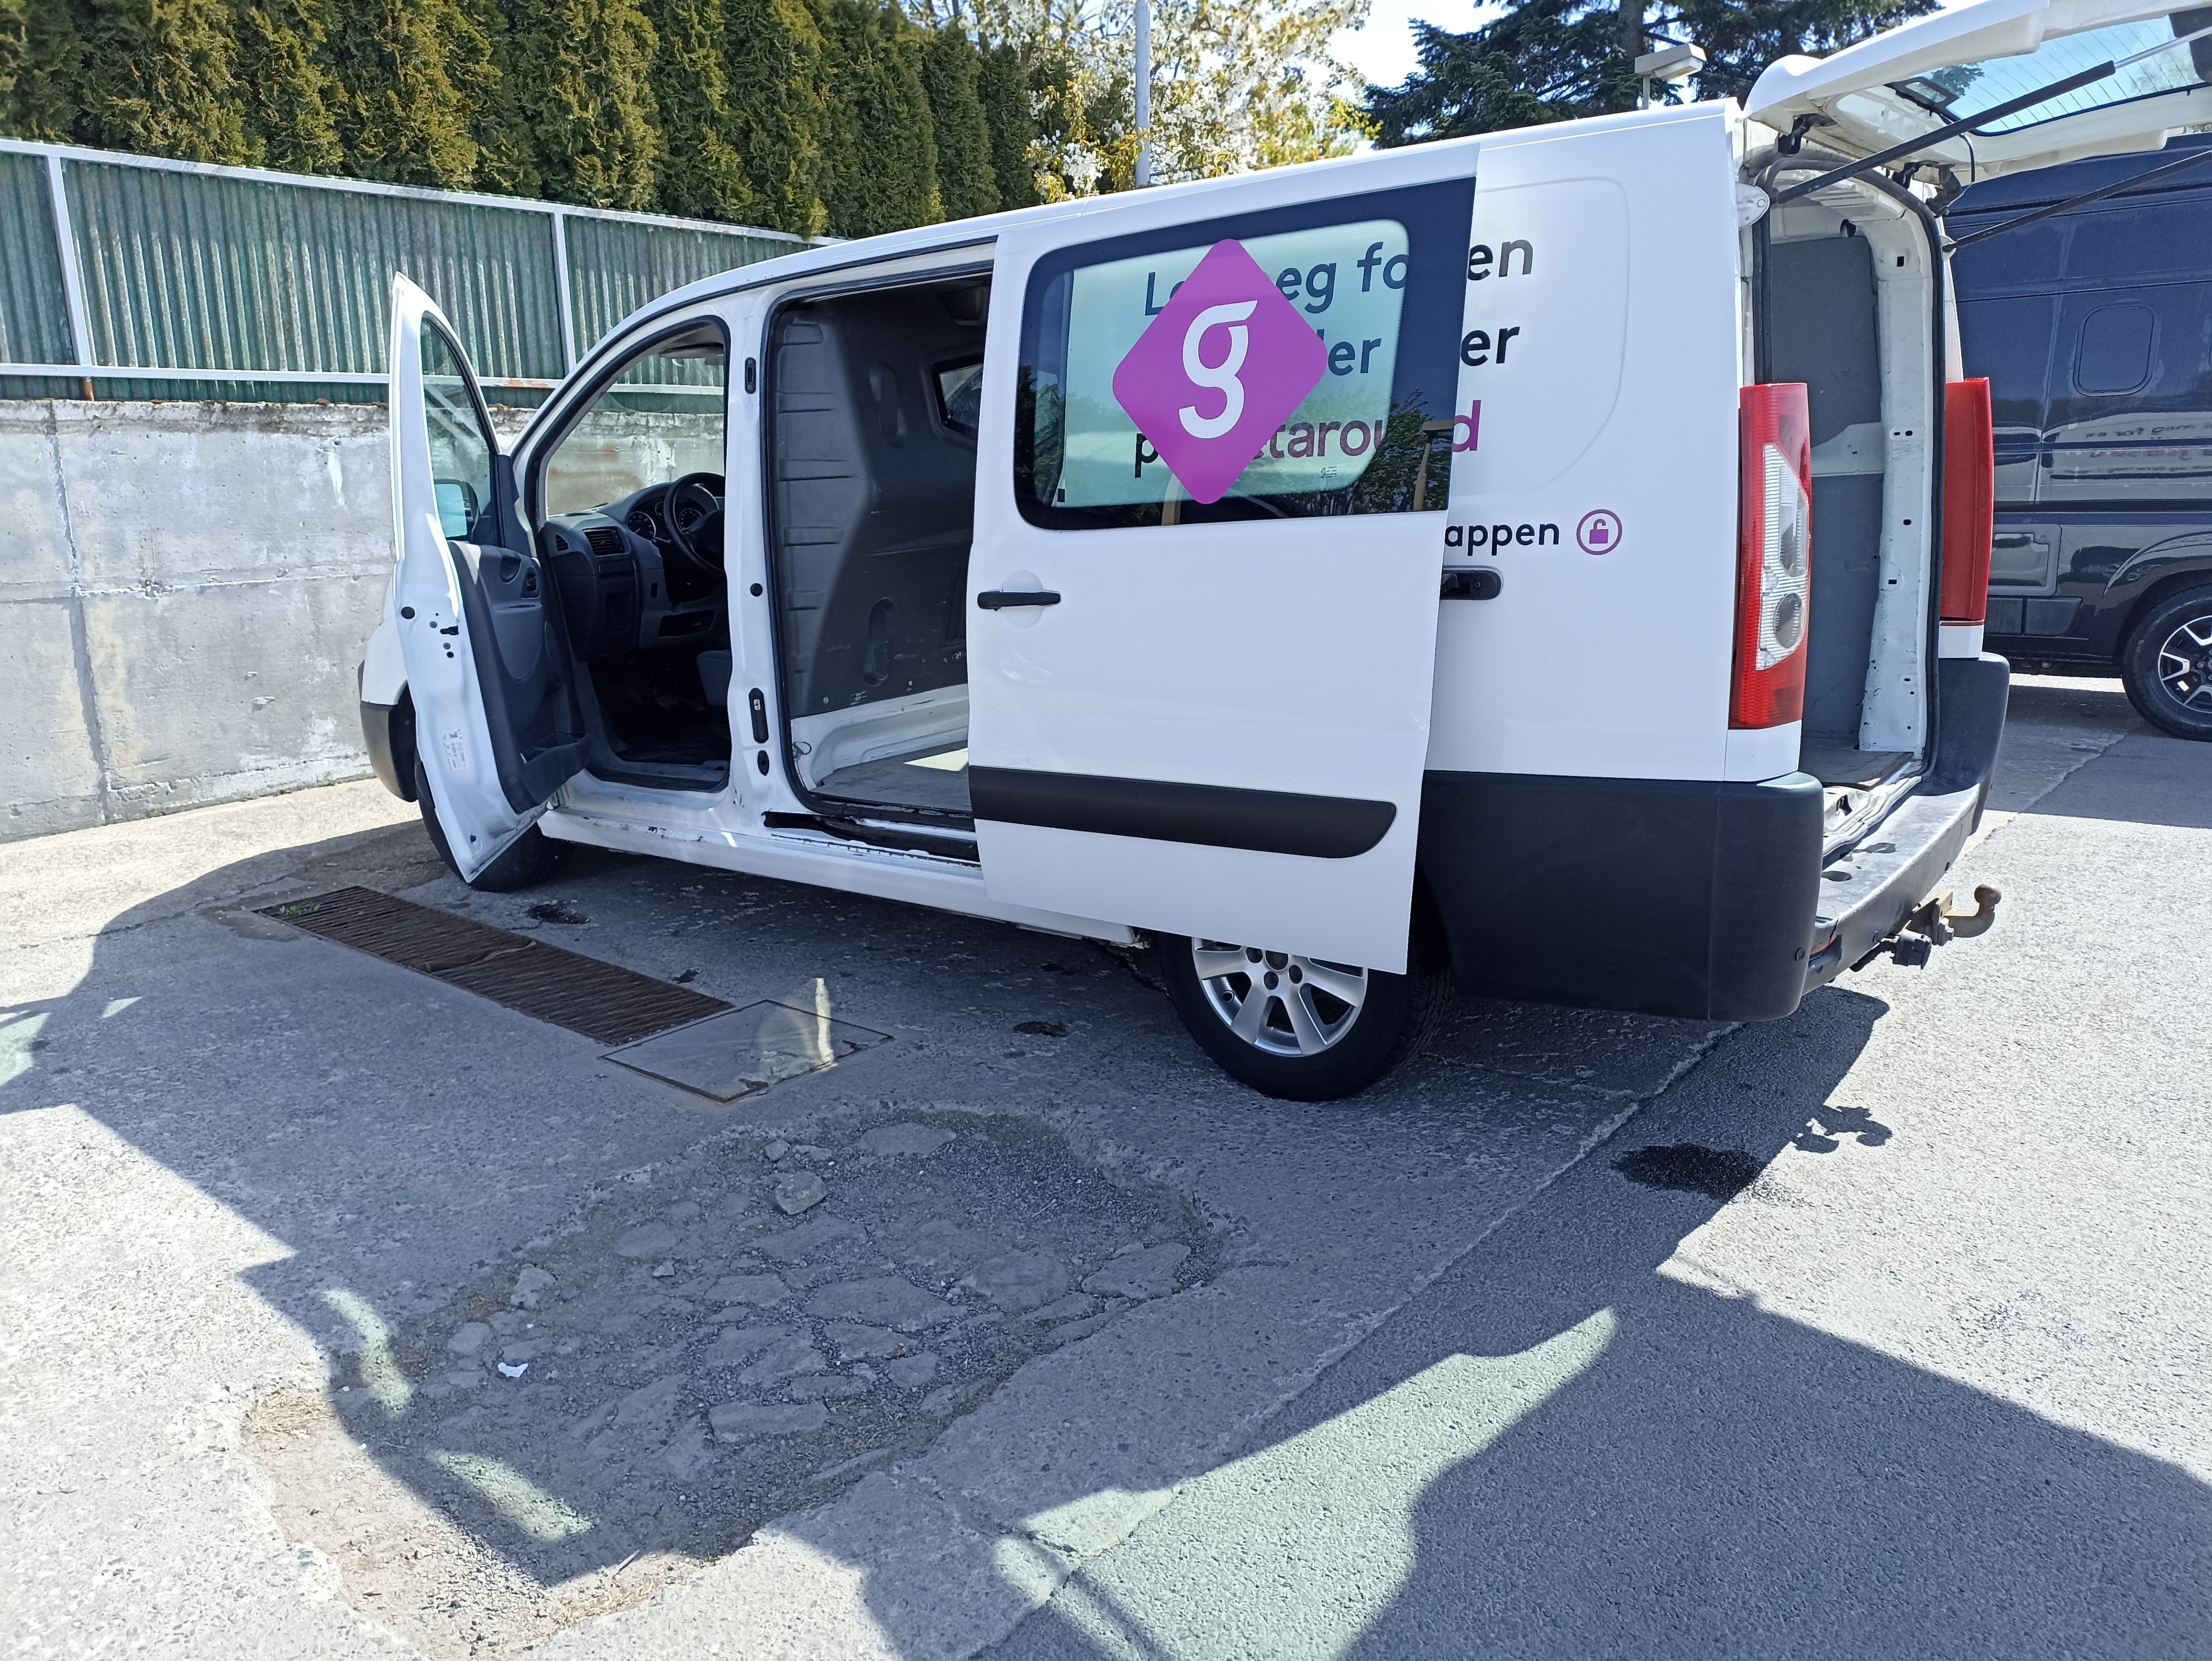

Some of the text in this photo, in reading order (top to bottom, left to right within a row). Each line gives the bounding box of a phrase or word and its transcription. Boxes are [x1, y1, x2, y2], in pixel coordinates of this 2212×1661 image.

[1276, 263, 1337, 314] eg
[1357, 242, 1409, 292] fo
[1444, 523, 1560, 556] appen
